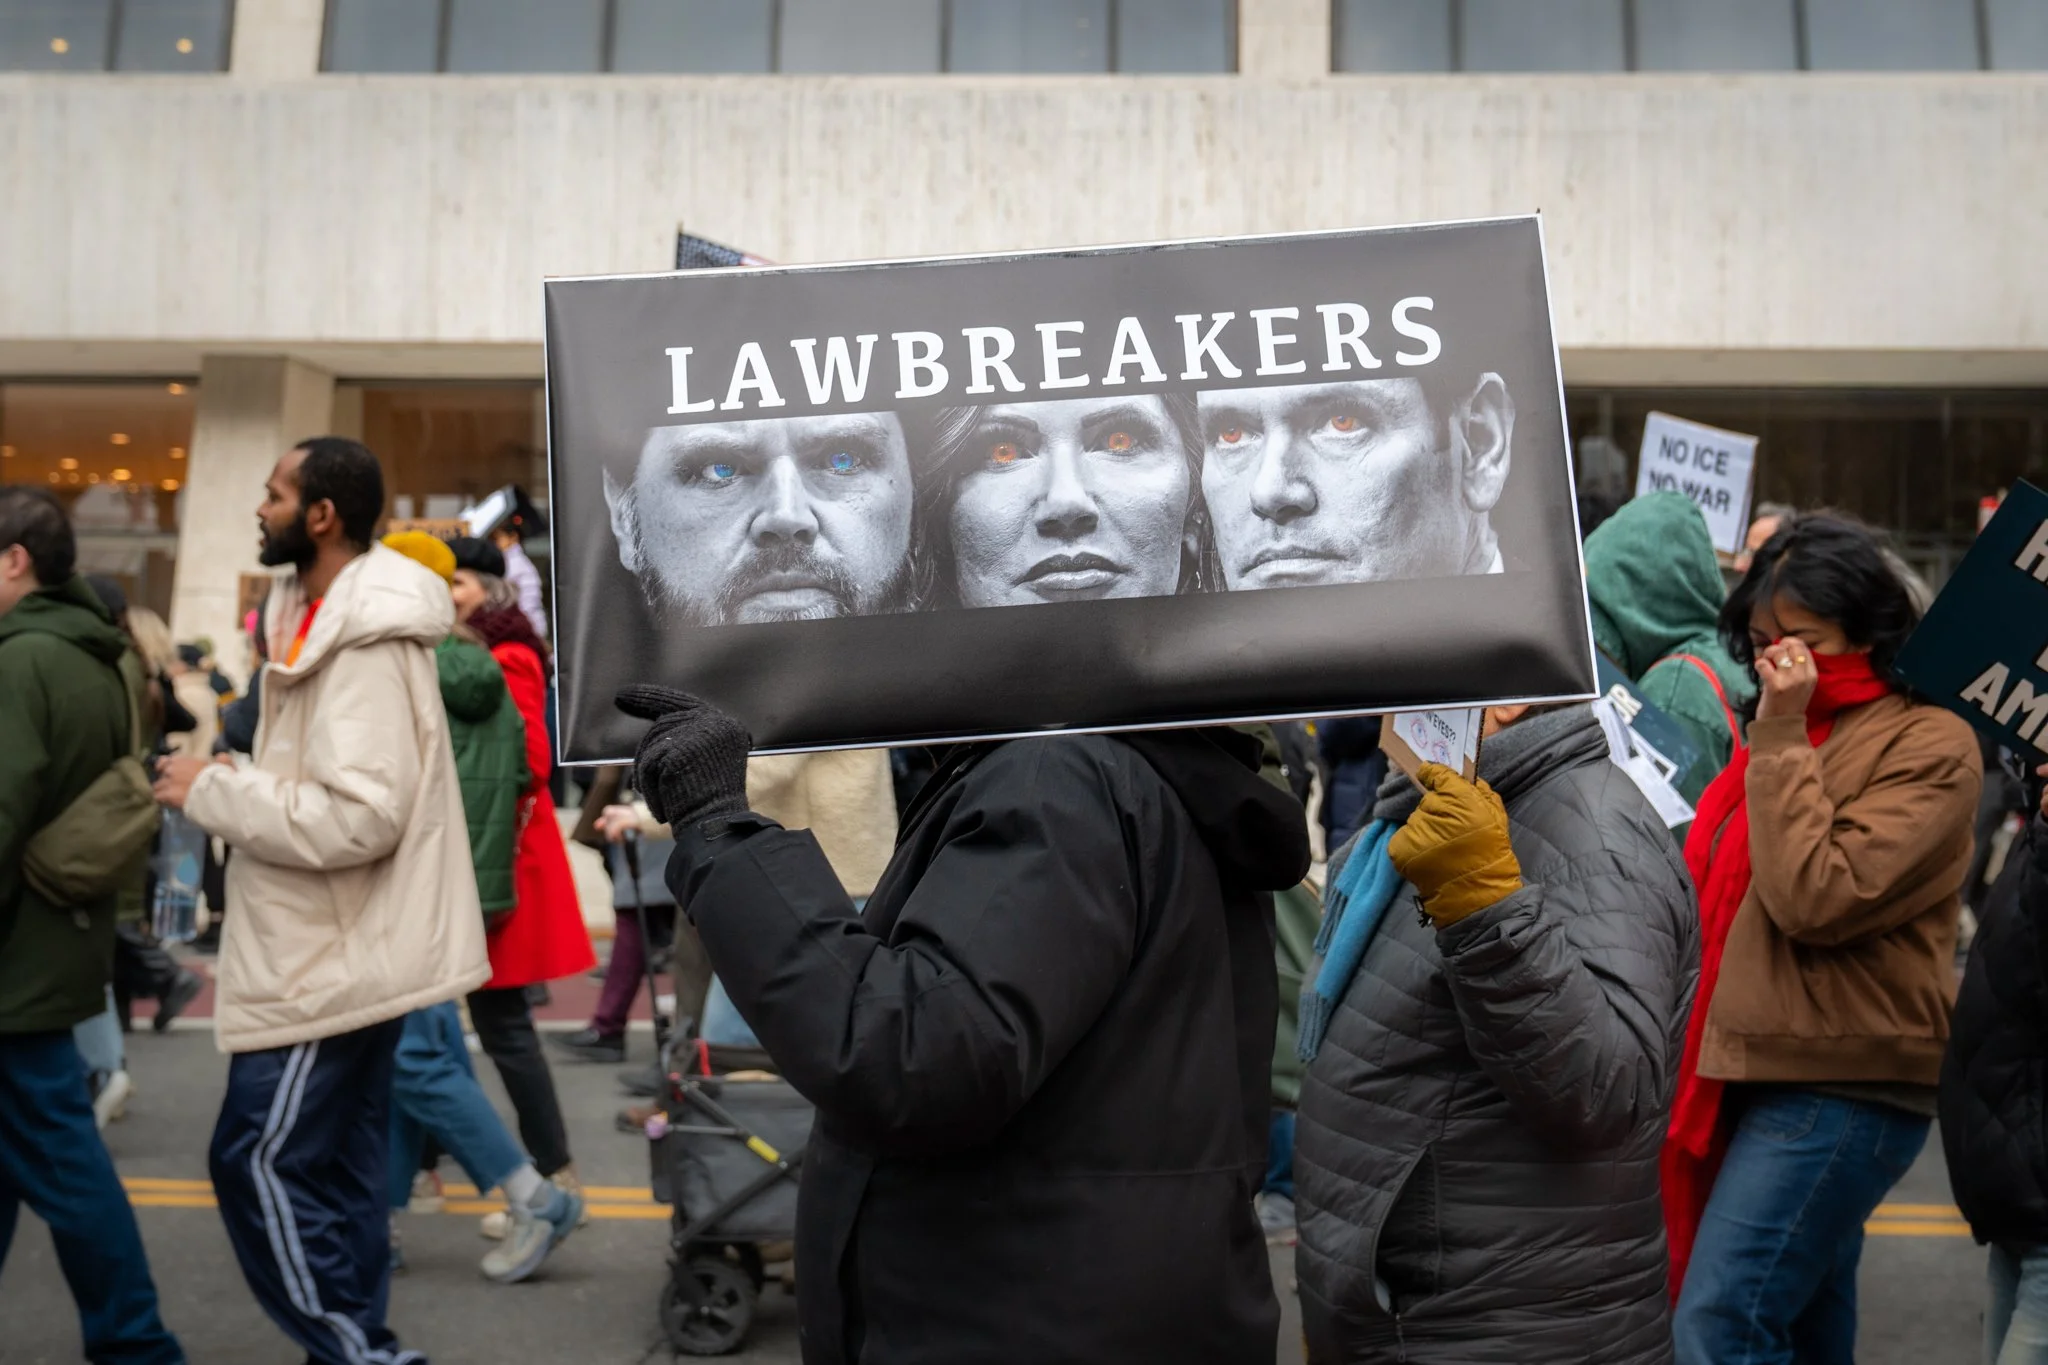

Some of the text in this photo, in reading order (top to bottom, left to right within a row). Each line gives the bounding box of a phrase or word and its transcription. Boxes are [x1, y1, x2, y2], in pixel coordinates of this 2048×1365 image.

[665, 296, 1443, 414] LAWBREAKERS
[1660, 435, 1730, 476] NO ICE
[1682, 480, 1729, 515] WAR
